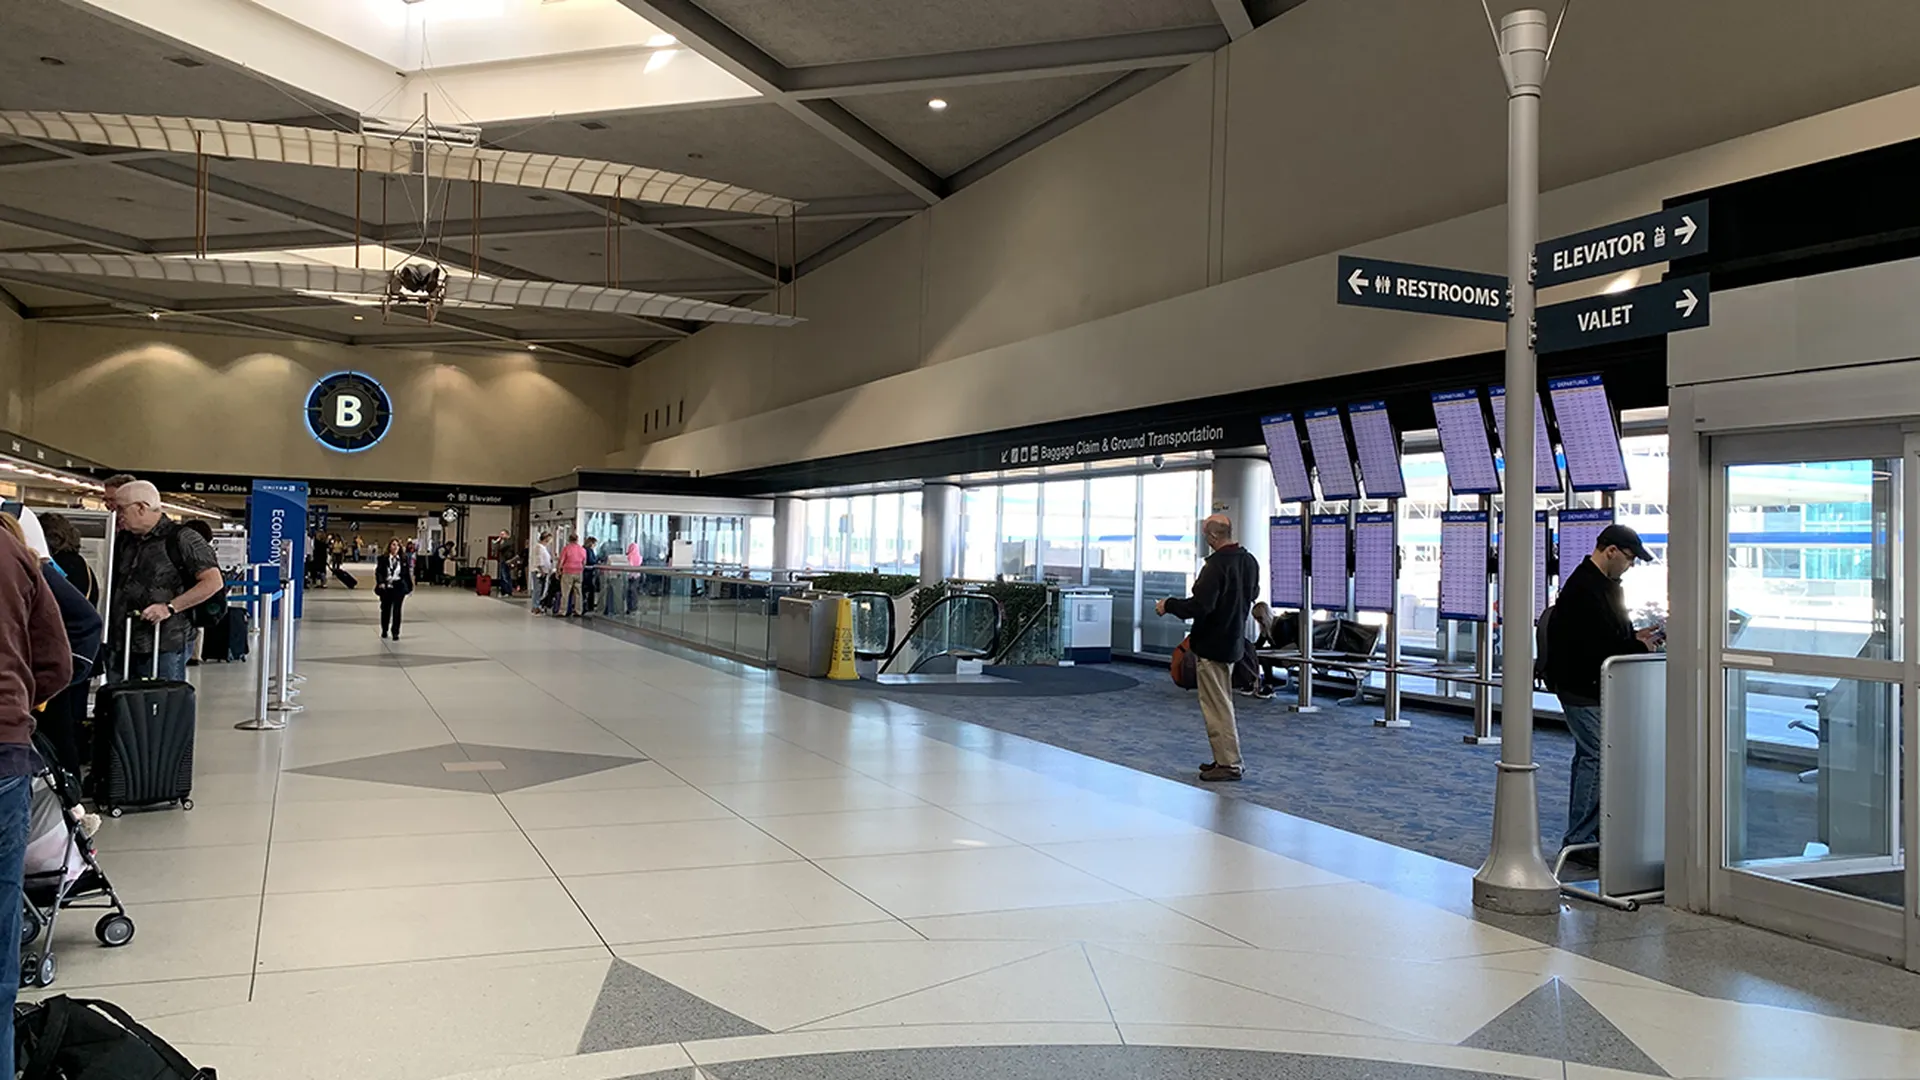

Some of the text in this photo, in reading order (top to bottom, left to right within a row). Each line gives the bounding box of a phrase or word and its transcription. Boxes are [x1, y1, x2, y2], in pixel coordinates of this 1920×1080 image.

[1552, 230, 1646, 272] ELEVATOR
[1395, 277, 1500, 308] RESTROOMS
[1576, 304, 1634, 333] VALET
[335, 394, 363, 428] B
[1041, 426, 1224, 461] Baggage Claim & Ground Transportation
[222, 484, 247, 493] Gates
[352, 490, 400, 498] Checkpoint
[469, 494, 502, 502] Elevator
[268, 509, 285, 566] Economy
